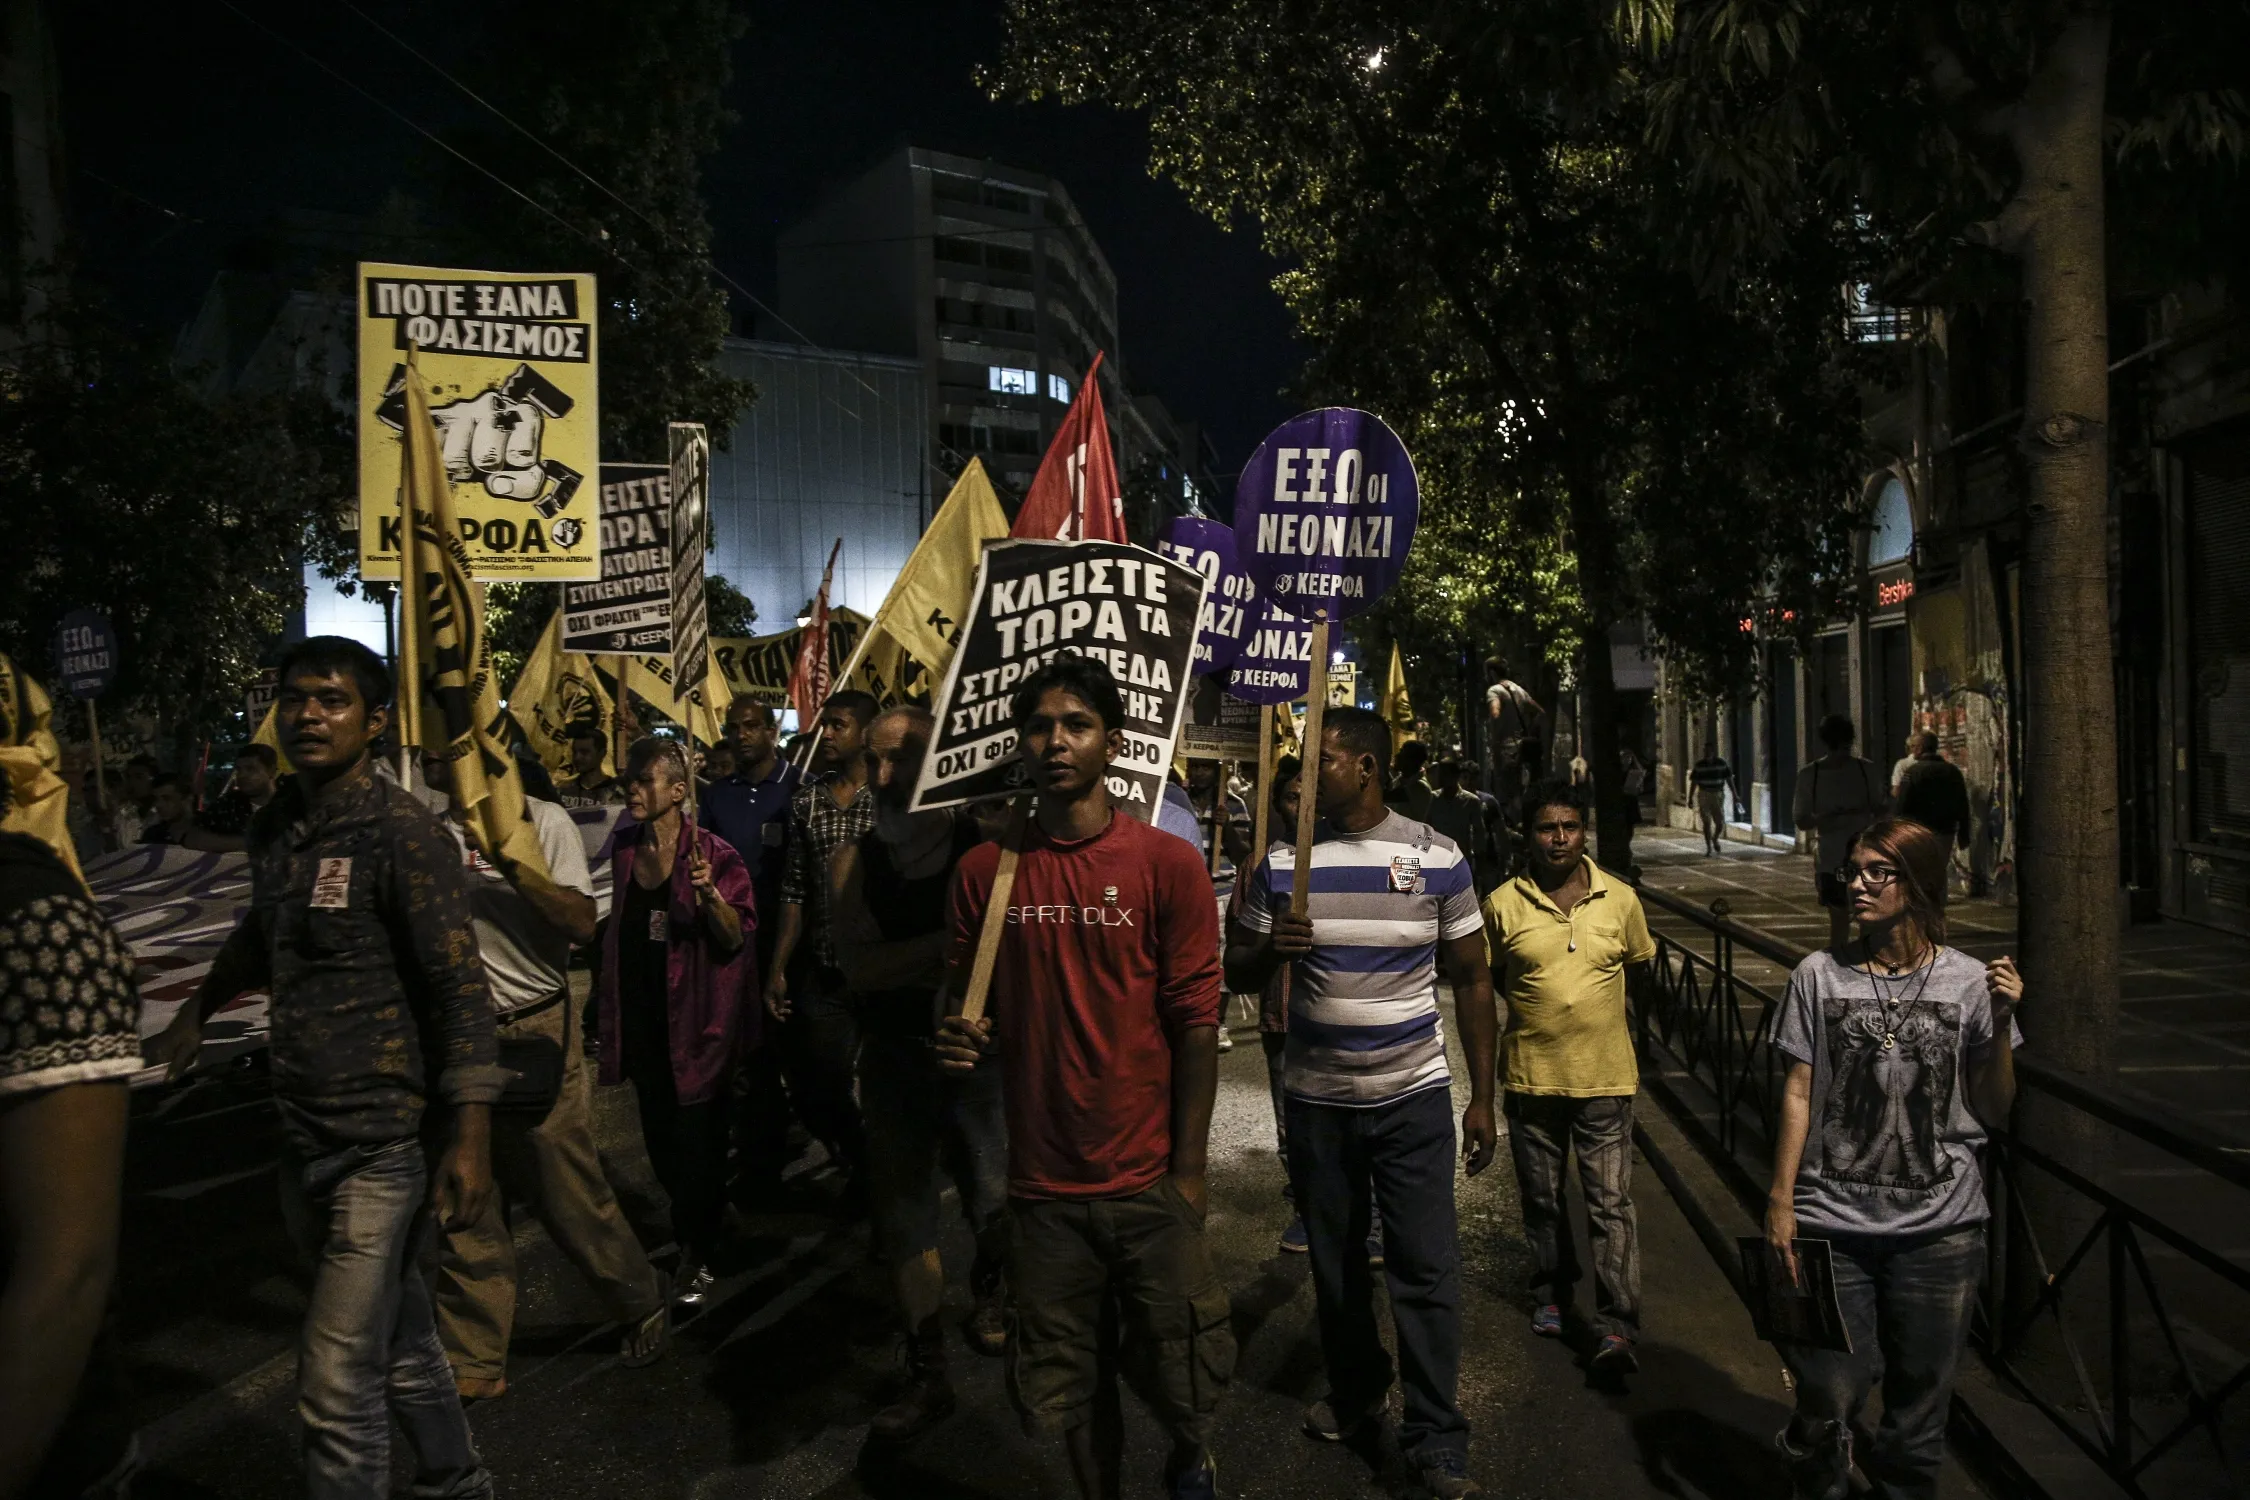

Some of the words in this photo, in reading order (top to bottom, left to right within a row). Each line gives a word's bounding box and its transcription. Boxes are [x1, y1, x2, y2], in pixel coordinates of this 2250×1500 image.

[375, 282, 468, 316] ΠΟΤΕ
[473, 284, 568, 317] ΞΑΝΑ
[404, 315, 585, 358] ΦΑΣΙΣΜΟΣ
[1273, 447, 1363, 504] ΕΞΩ
[600, 475, 670, 515] ΕΙΣΤΕ
[600, 512, 658, 550] ΩΡΑ
[1256, 513, 1393, 558] ΝΕΟΝΑΖΙ
[989, 558, 1168, 618] ΚΛΕΙΣΤΕ
[1296, 571, 1364, 598] ΚΕΕΡΦΑ
[1878, 578, 1916, 606] Bershka
[567, 615, 591, 632] ΟΧΙ
[594, 608, 641, 627] ΦΡΑΧΤΗ
[995, 600, 1127, 659] ΤΩΡΑ
[1134, 603, 1171, 637] ΤΑ
[1243, 669, 1298, 689] ΚΕΕΡΦΑ
[935, 747, 976, 780] ΟΧΙ
